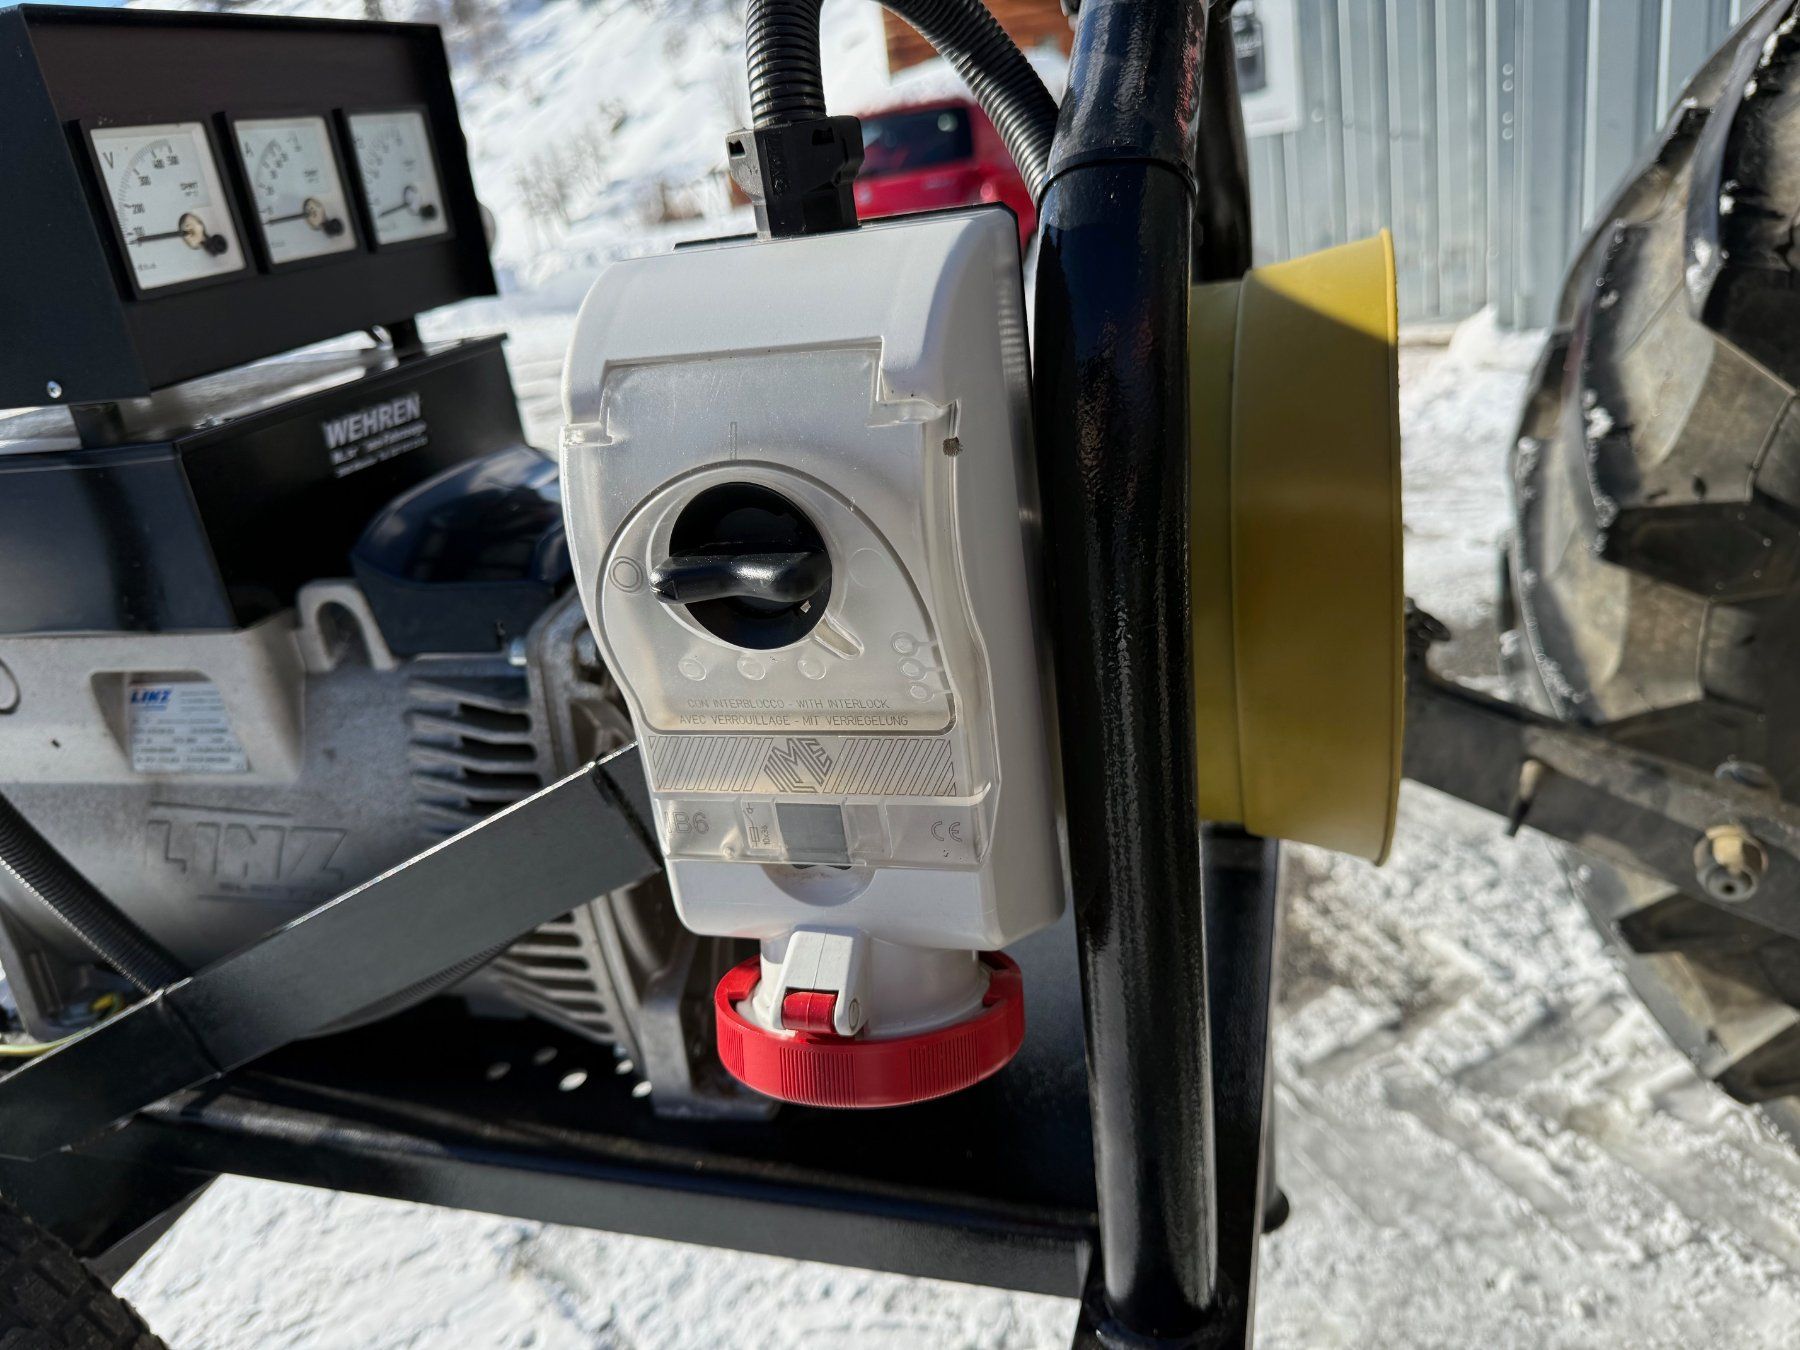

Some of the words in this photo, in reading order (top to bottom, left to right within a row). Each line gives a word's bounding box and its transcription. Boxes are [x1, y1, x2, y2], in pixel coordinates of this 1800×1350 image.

[103, 151, 115, 169] V
[323, 392, 422, 449] WEHREN
[131, 687, 172, 705] LINZ
[687, 699, 709, 709] CON
[713, 698, 785, 709] INTERBLOCCO
[796, 699, 823, 709] WITH
[827, 699, 890, 709] INTERLOCK
[680, 715, 706, 725] AVEC
[711, 715, 790, 726] VERROUILLAGE
[802, 716, 820, 726] MIT
[825, 716, 908, 726] VERRIEGELUNG
[146, 820, 347, 882] LINZ
